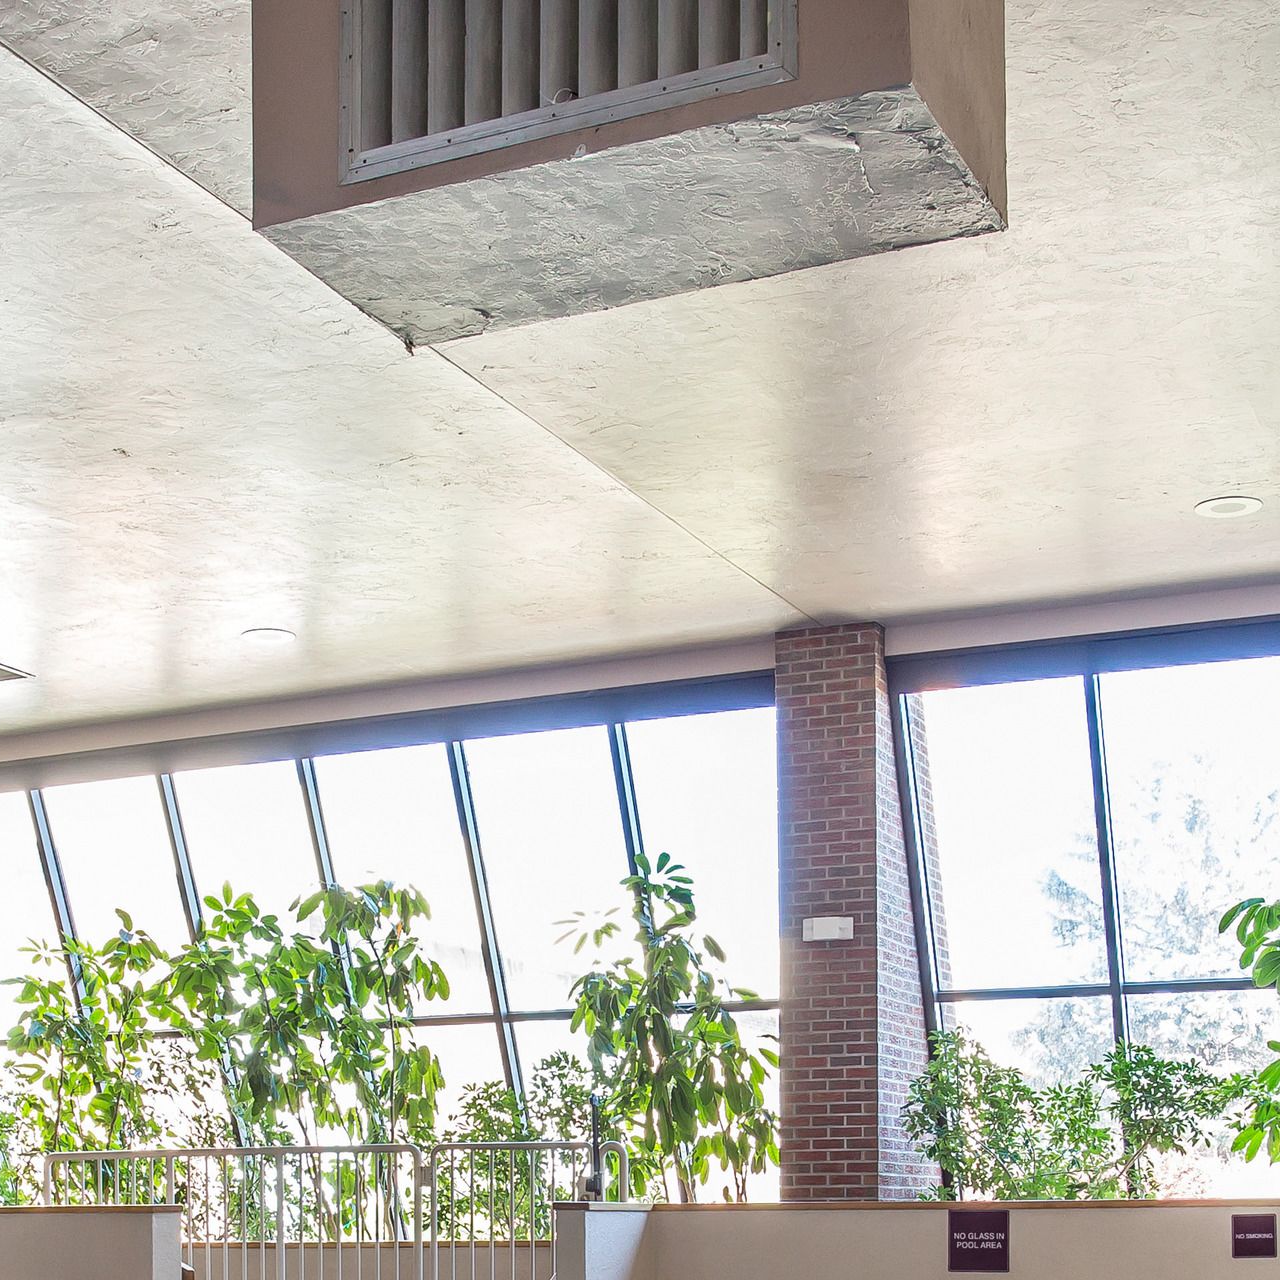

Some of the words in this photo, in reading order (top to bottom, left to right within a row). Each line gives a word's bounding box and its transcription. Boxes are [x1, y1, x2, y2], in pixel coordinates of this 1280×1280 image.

[953, 1232, 966, 1240] NO
[967, 1232, 995, 1240] GLASS
[996, 1232, 1005, 1240] IN
